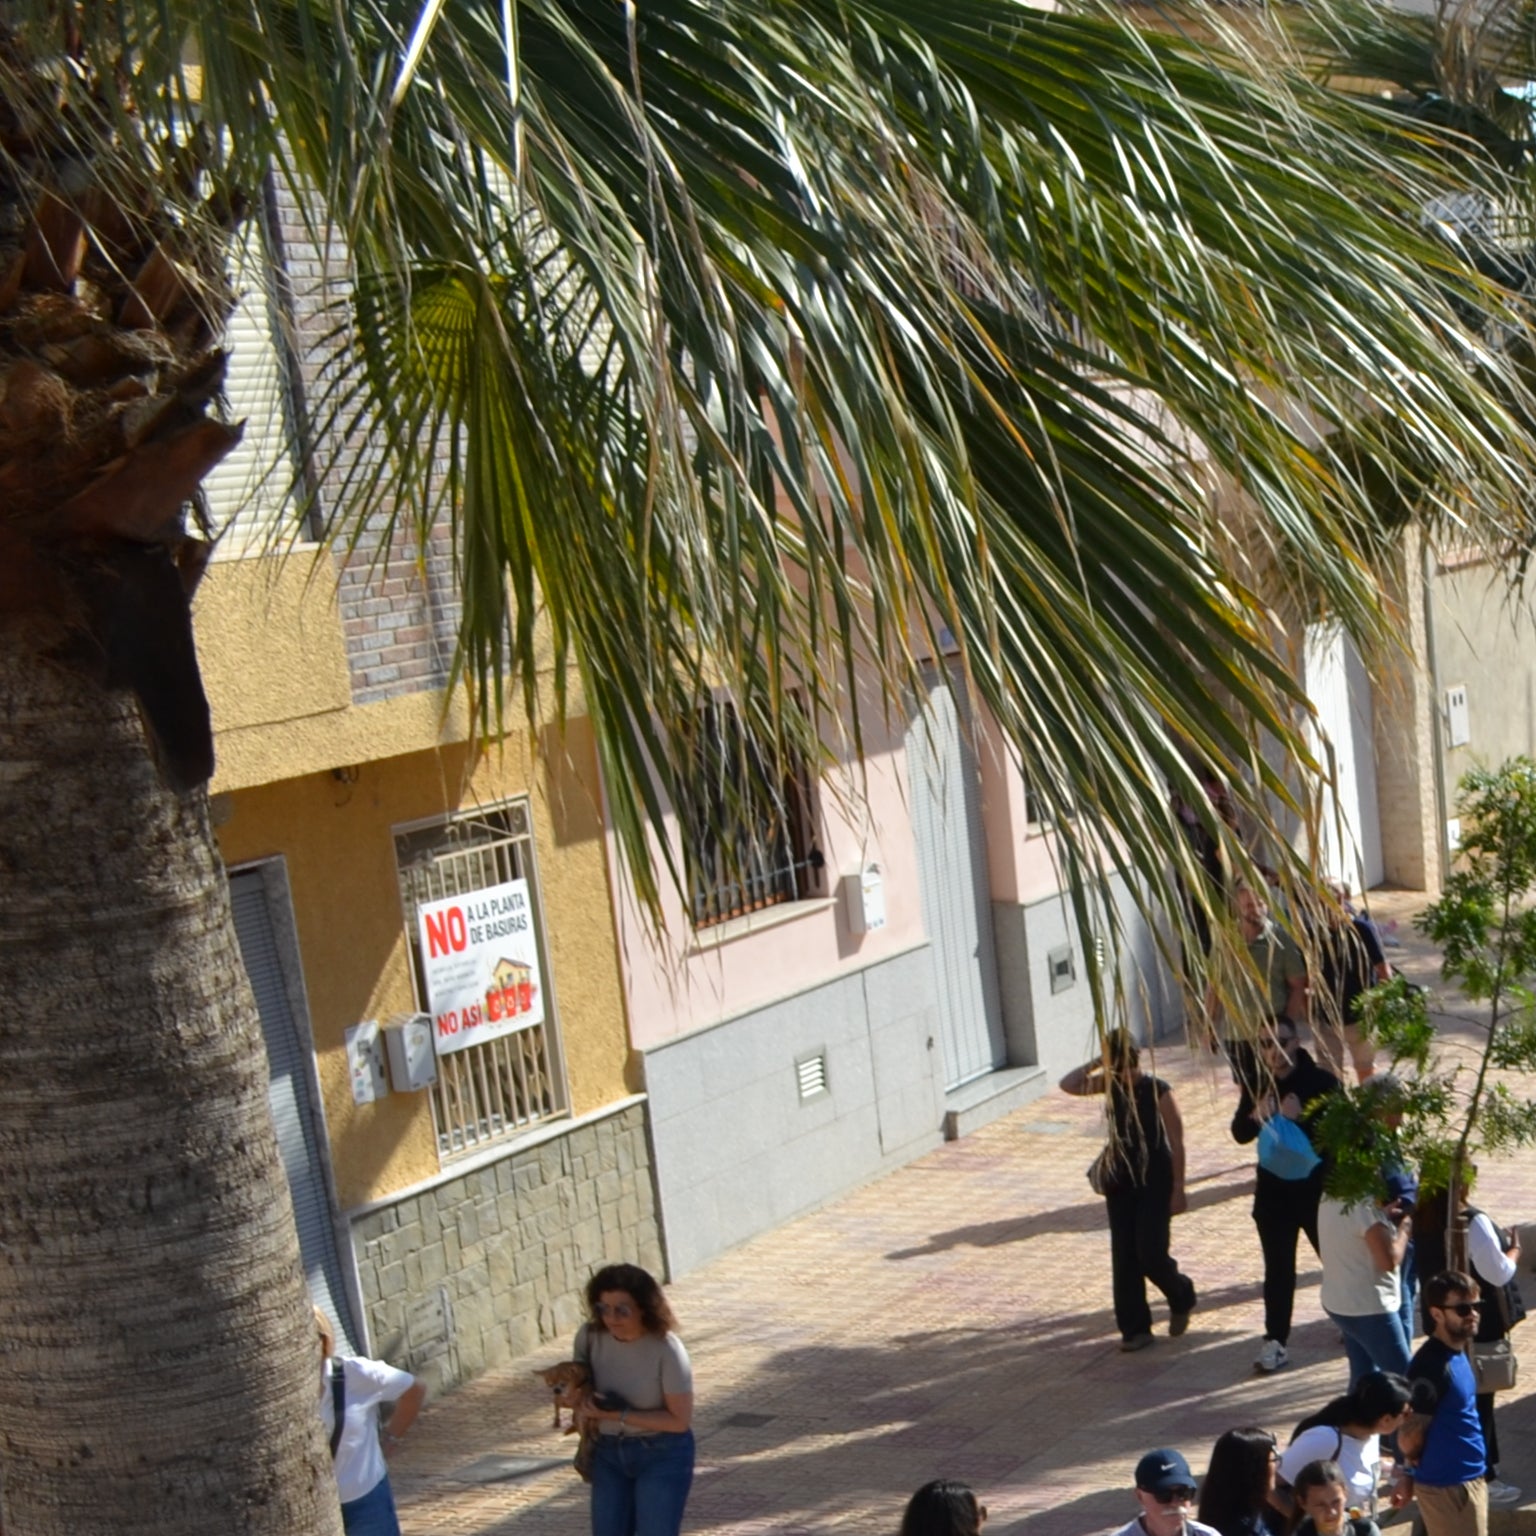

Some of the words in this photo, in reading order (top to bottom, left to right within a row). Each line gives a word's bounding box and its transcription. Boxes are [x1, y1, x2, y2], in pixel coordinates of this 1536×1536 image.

[467, 904, 476, 922] A
[475, 901, 490, 920] LA
[490, 892, 526, 916] PLANTA
[425, 906, 467, 959] NO
[470, 926, 485, 945] DE
[485, 913, 528, 941] BASURAS
[437, 1011, 458, 1037] NO
[462, 999, 483, 1029] ASÍ
